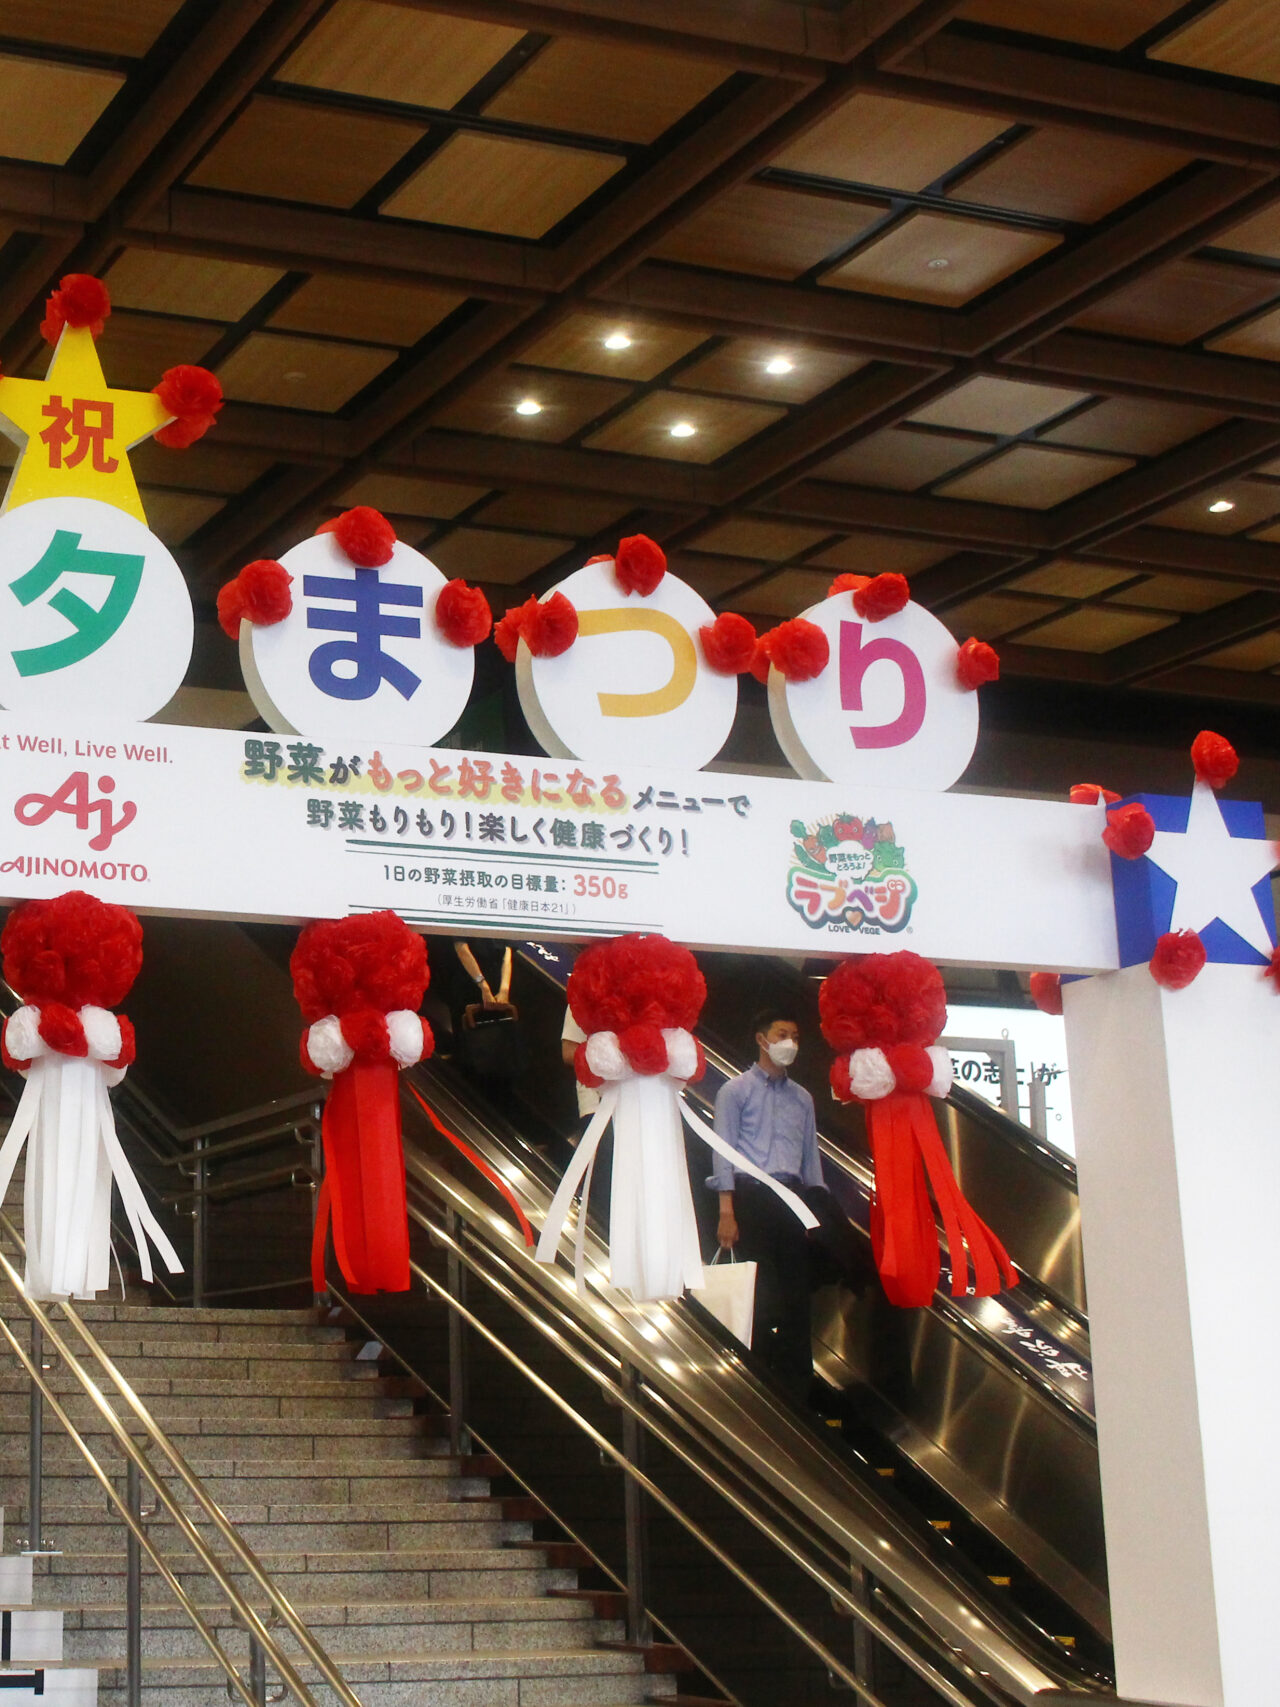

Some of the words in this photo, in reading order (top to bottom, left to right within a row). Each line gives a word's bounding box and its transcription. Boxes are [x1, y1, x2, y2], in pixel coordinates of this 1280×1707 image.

[40, 395, 119, 474] 祝
[17, 735, 68, 757] Well,
[75, 740, 117, 759] Live
[123, 743, 173, 764] Well.
[0, 856, 148, 882] AJINOMOTO
[794, 876, 906, 919] ラブベジ
[828, 924, 850, 934] LOVE
